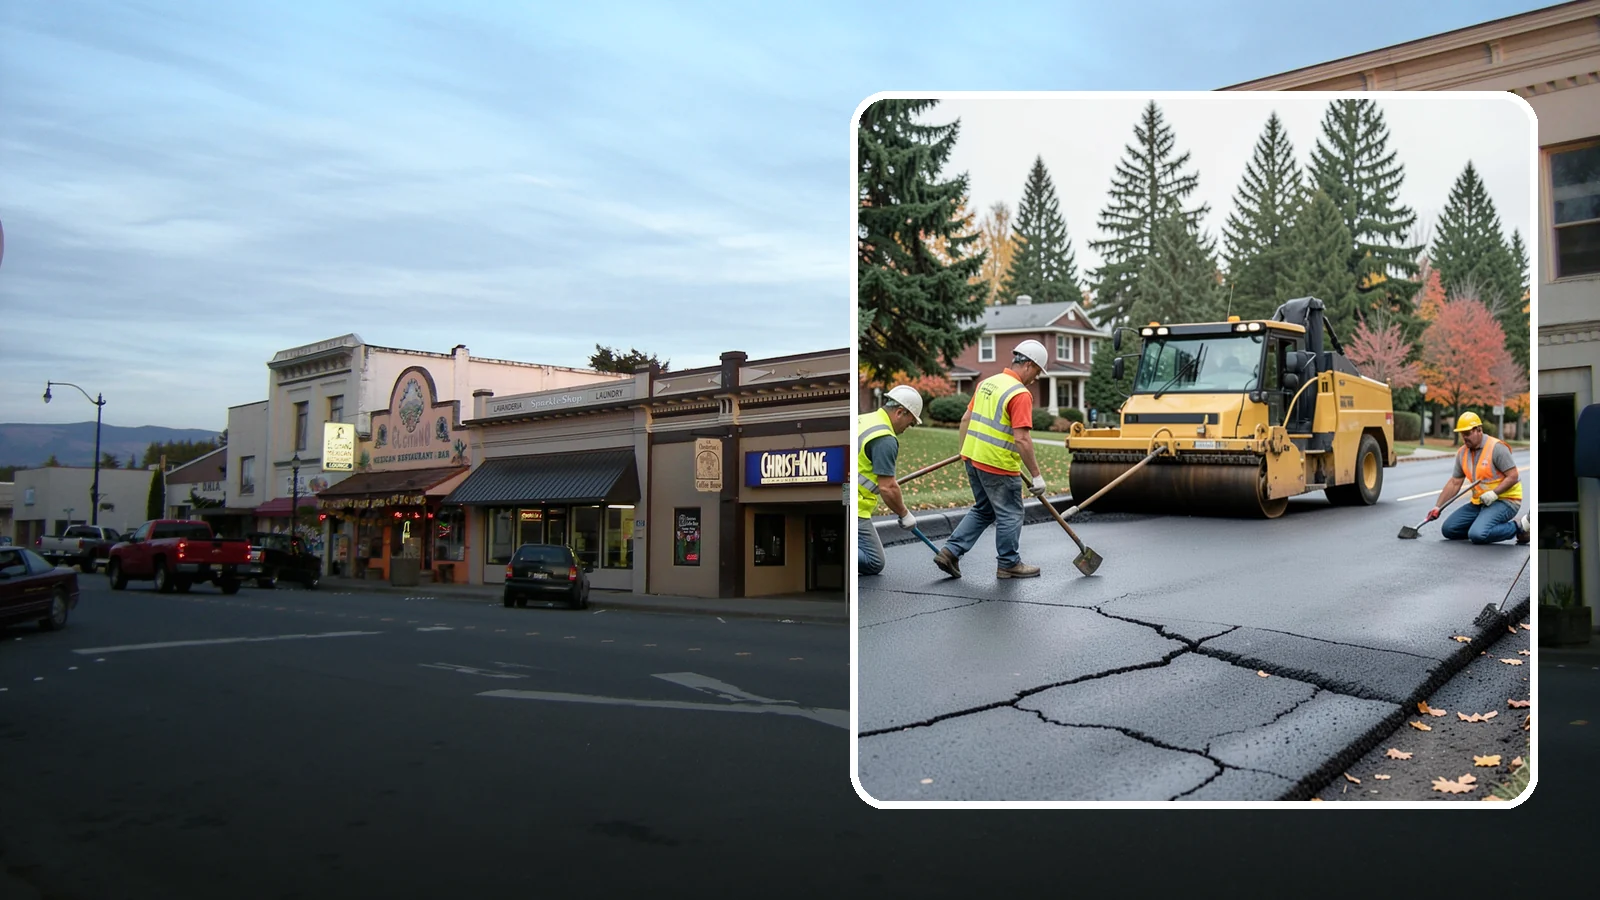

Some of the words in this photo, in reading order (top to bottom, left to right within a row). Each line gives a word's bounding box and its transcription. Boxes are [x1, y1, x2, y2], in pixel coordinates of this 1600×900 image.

[493, 402, 522, 413] LAVANDERIA
[531, 396, 560, 409] Sparkle
[561, 394, 583, 406] Shop
[595, 389, 623, 400] LAUNDRY
[373, 455, 395, 464] MEXICAN
[397, 451, 433, 462] RESTAURANT
[437, 450, 450, 459] BAR
[761, 452, 797, 478] CHRIST
[799, 449, 827, 476] KING
[696, 480, 709, 489] Coffee
[710, 480, 722, 489] House
